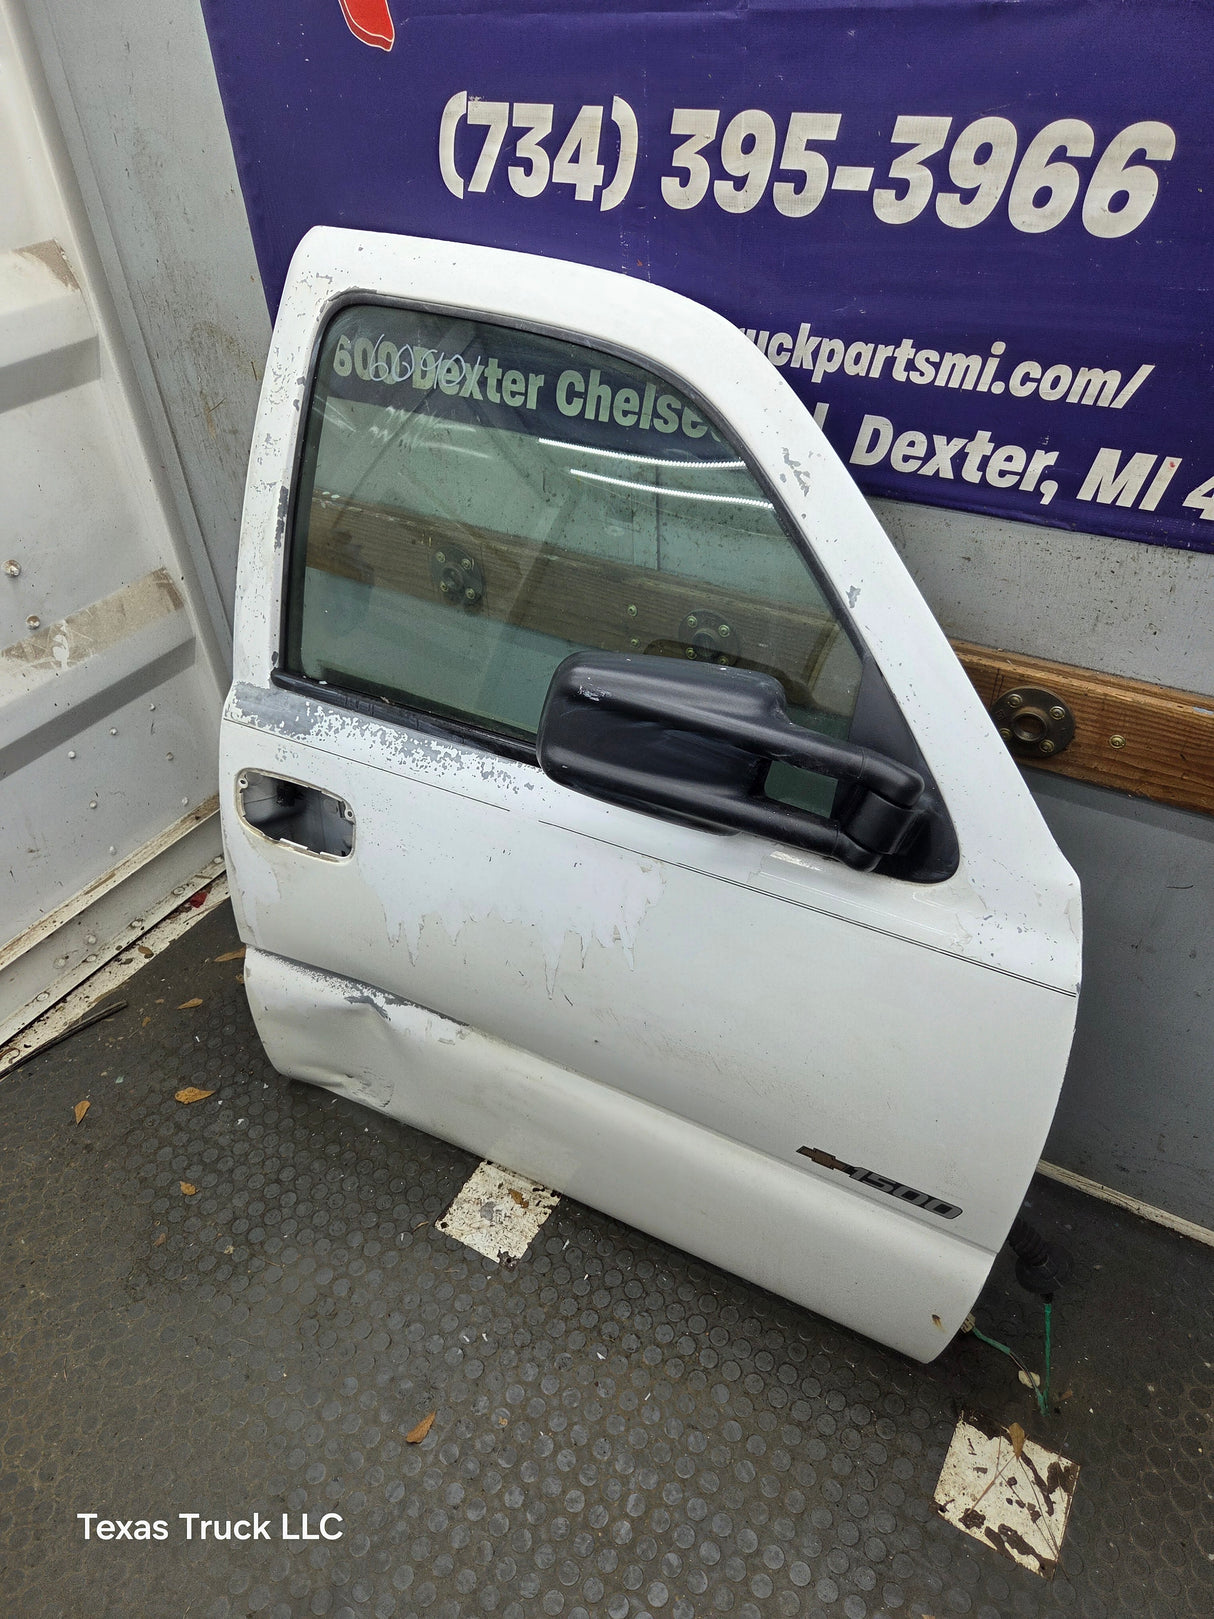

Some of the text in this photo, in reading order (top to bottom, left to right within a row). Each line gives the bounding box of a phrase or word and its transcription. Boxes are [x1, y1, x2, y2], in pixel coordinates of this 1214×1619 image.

[439, 91, 1176, 238] (734) 395-3966
[333, 334, 400, 385] 600
[412, 346, 545, 410] Dexter
[556, 369, 721, 442] Chelse
[849, 414, 1060, 505] Dexter,
[1076, 447, 1183, 512] MI
[740, 322, 1155, 409] uckpartsmi.com/
[849, 1166, 963, 1219] 1500
